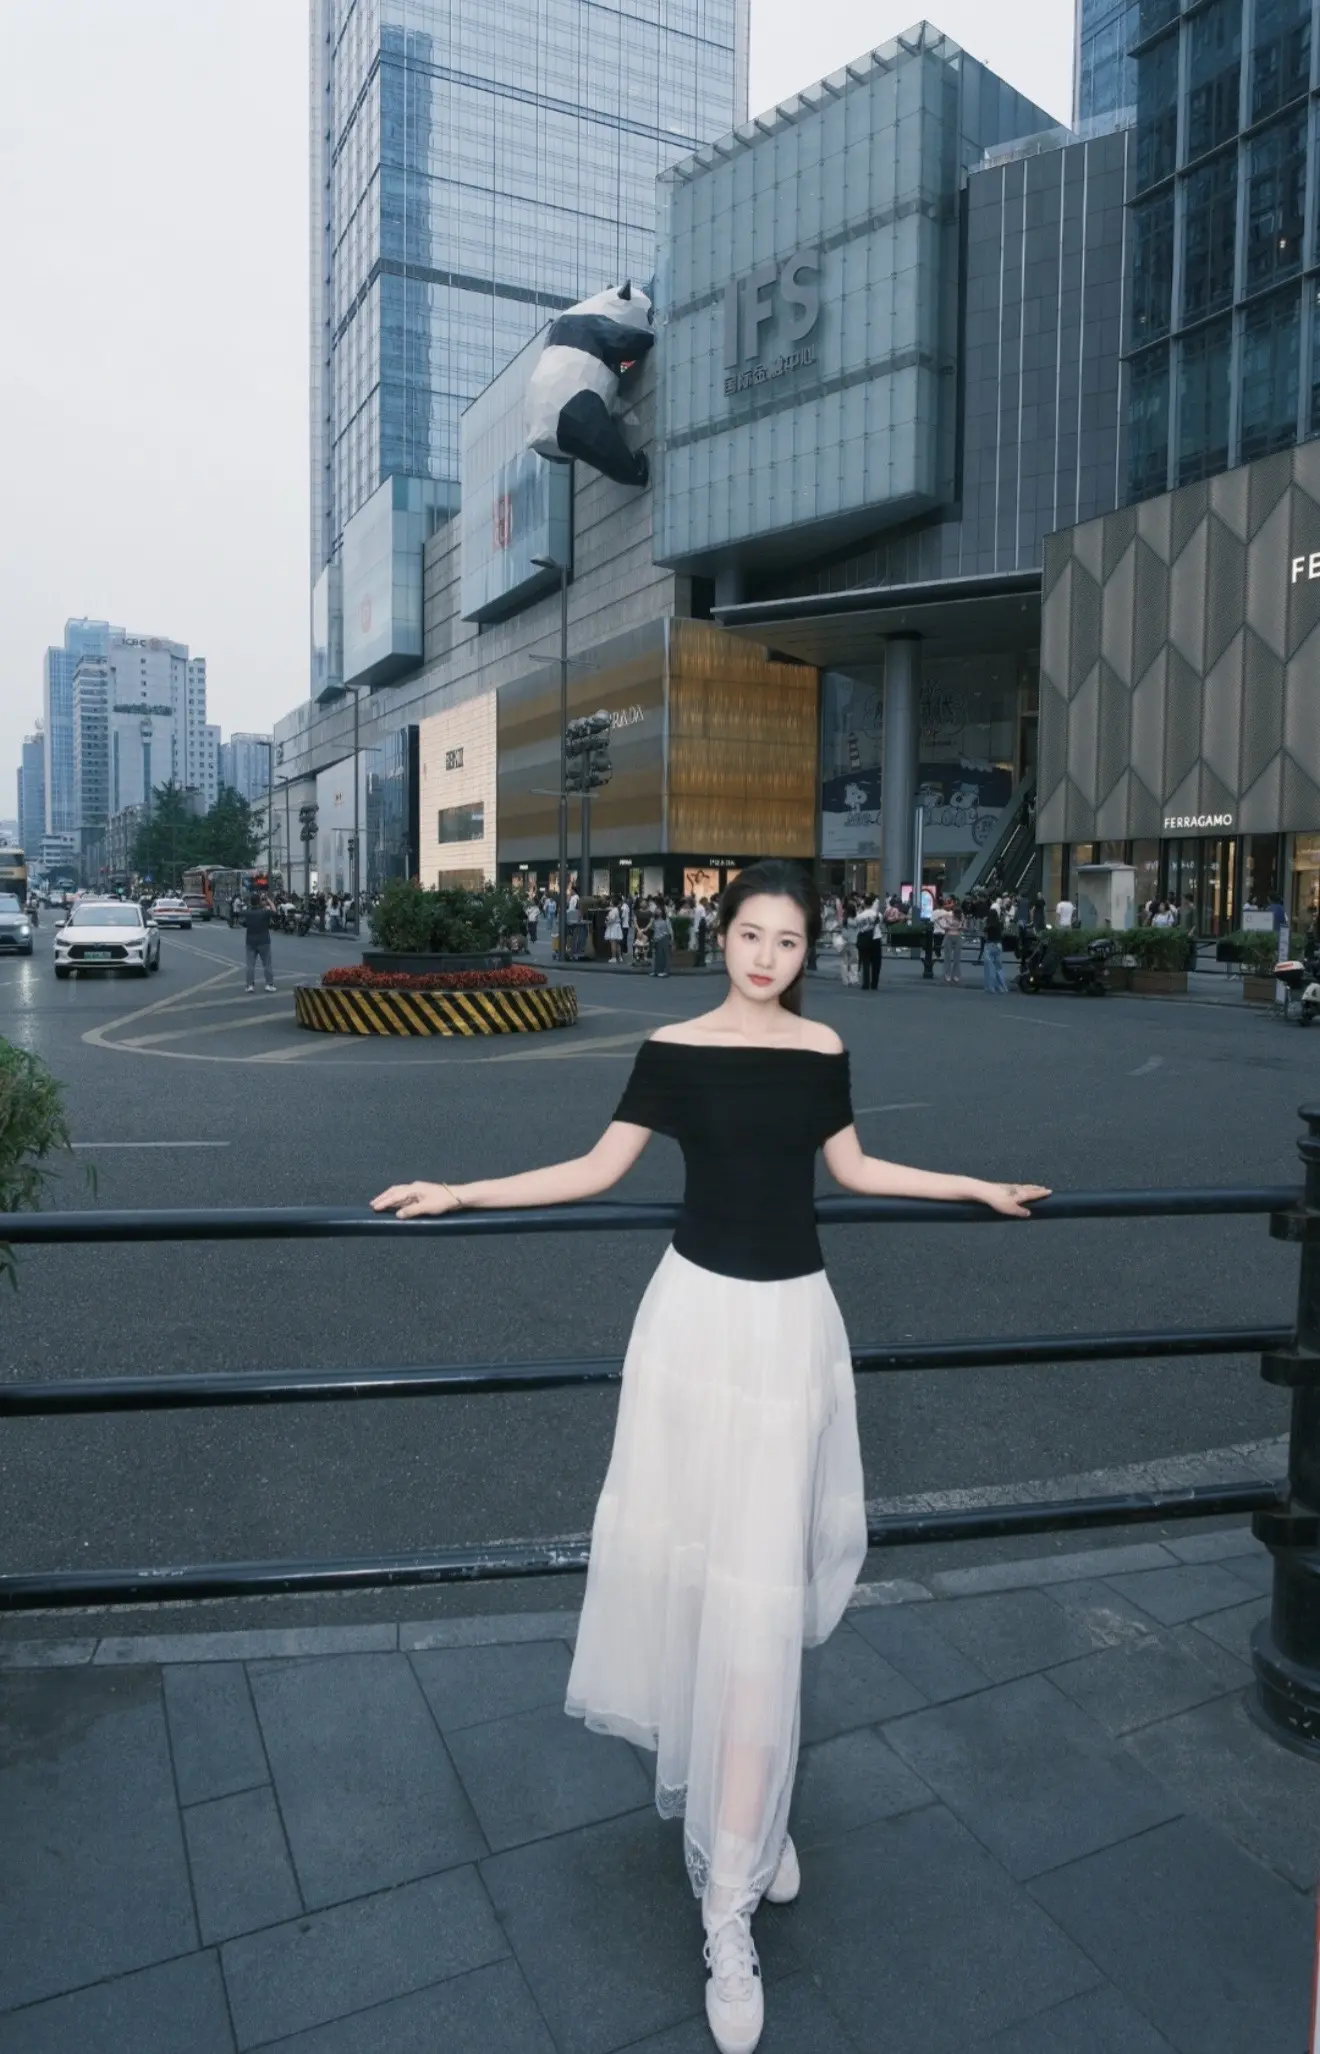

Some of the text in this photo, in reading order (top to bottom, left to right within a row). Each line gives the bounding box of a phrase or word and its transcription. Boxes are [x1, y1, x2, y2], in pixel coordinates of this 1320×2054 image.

[724, 248, 819, 370] IFS
[1291, 551, 1320, 583] FE
[1164, 813, 1233, 829] FERRAGAMO
